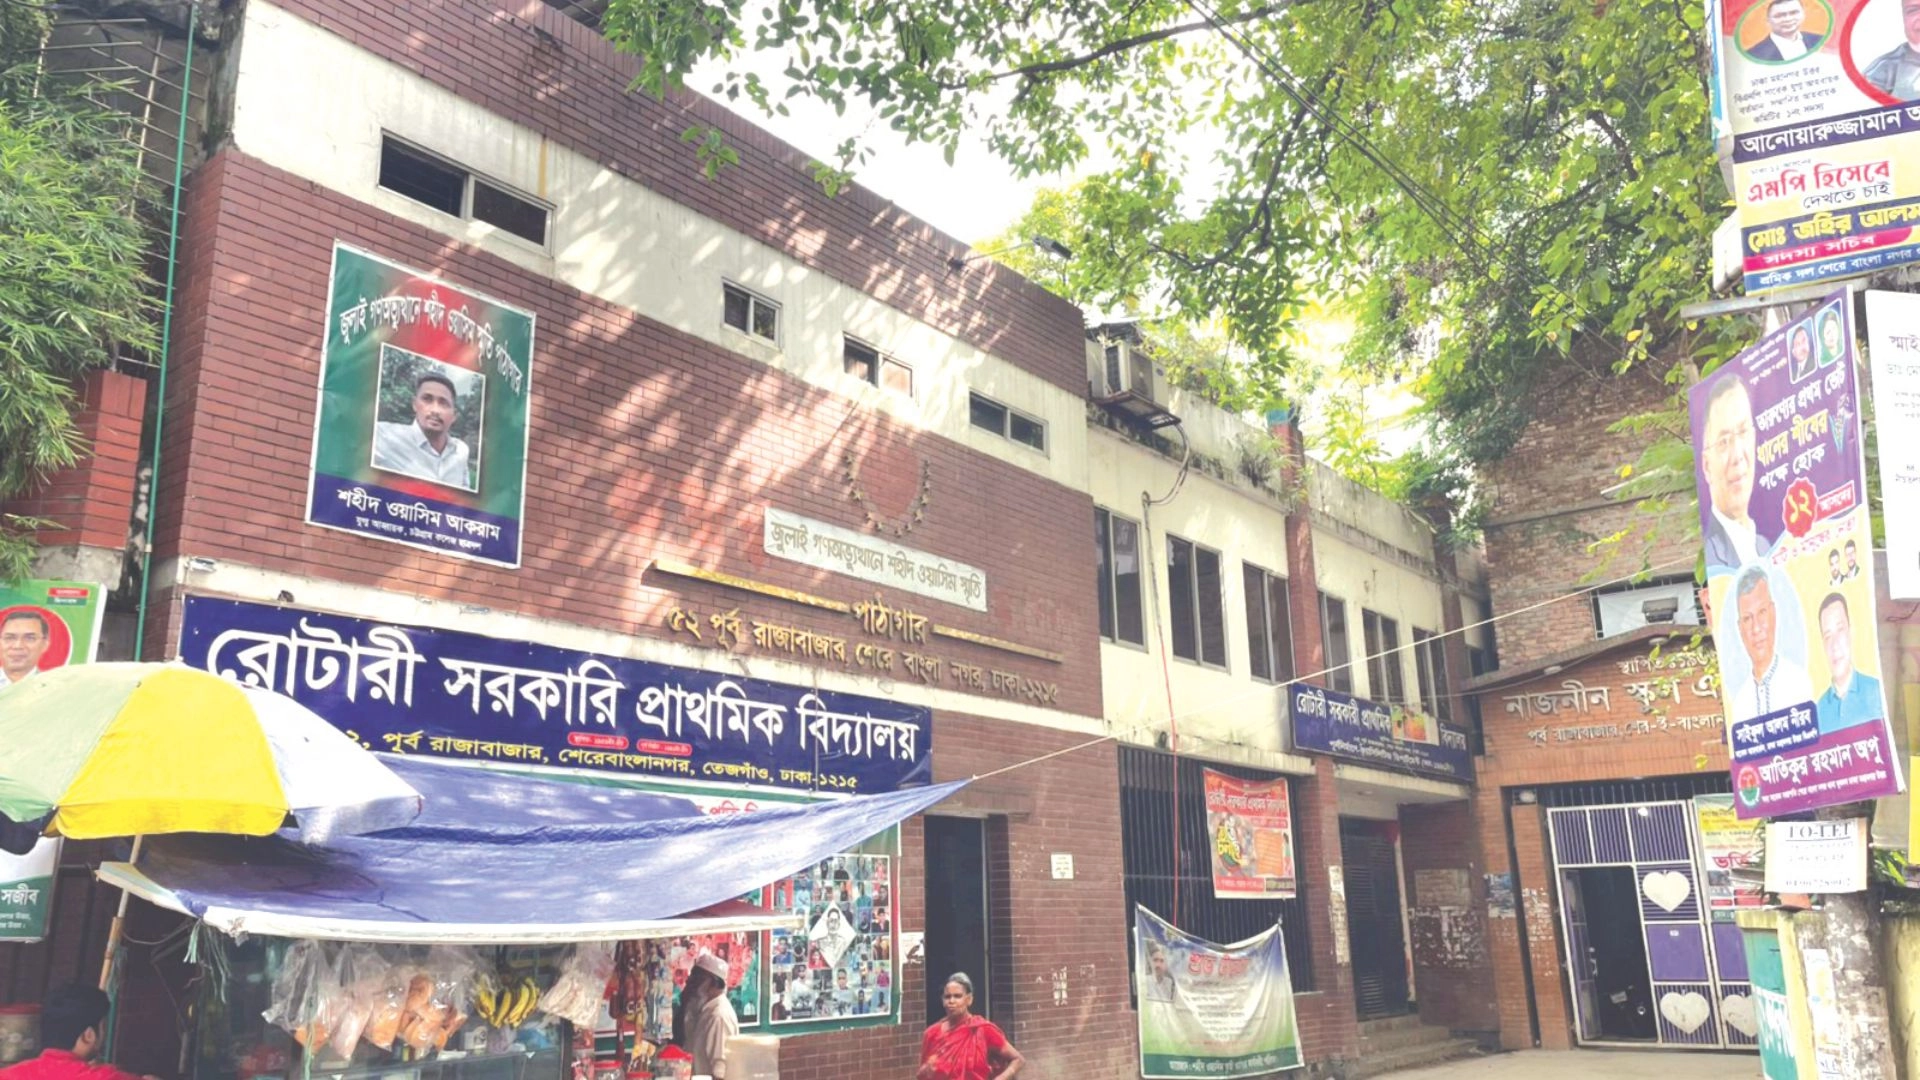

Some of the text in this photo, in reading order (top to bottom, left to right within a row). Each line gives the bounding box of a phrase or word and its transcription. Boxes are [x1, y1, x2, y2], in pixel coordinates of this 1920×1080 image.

[1740, 107, 1902, 154] আনোয়ারুজ্জামান
[1748, 161, 1890, 203] এমপি হিসেবে
[1803, 181, 1891, 209] দেখতে চাই
[1749, 225, 1787, 253] মোঃ
[1794, 211, 1852, 240] জহির
[1764, 234, 1876, 265] সদস্য সচিব
[339, 297, 369, 346] জুলাই
[337, 487, 501, 541] শহীদ ওয়াসিম আকরাম
[1786, 490, 1813, 524] ১২
[771, 520, 809, 555] জুলাই
[887, 550, 915, 581] শহীদ
[917, 562, 957, 593] ওয়াসিম
[853, 591, 929, 646] পাঠাগার
[667, 605, 703, 642] ৫২
[709, 606, 744, 652] পূর্ব
[855, 643, 894, 672] শেরে
[904, 650, 942, 684] বাংলা
[207, 616, 921, 763] রোটারী সরকারি প্রাথমিক বিদ্যালয়
[1296, 689, 1327, 719] রোটারী
[1503, 679, 1611, 723] নাজনীন
[345, 730, 370, 751] ২,
[383, 732, 424, 755] পূর্ব
[429, 737, 551, 764] রাজাবাজার,
[558, 749, 695, 776] শেরেবাংলানগর,
[702, 760, 776, 784] তেজগাঁও,
[780, 770, 858, 789] ঢাকা-১২১৫
[1758, 754, 1808, 784] আতিকুর
[1809, 745, 1853, 773] রহমান
[1854, 736, 1881, 765] অপু
[1, 883, 40, 906] সজীব
